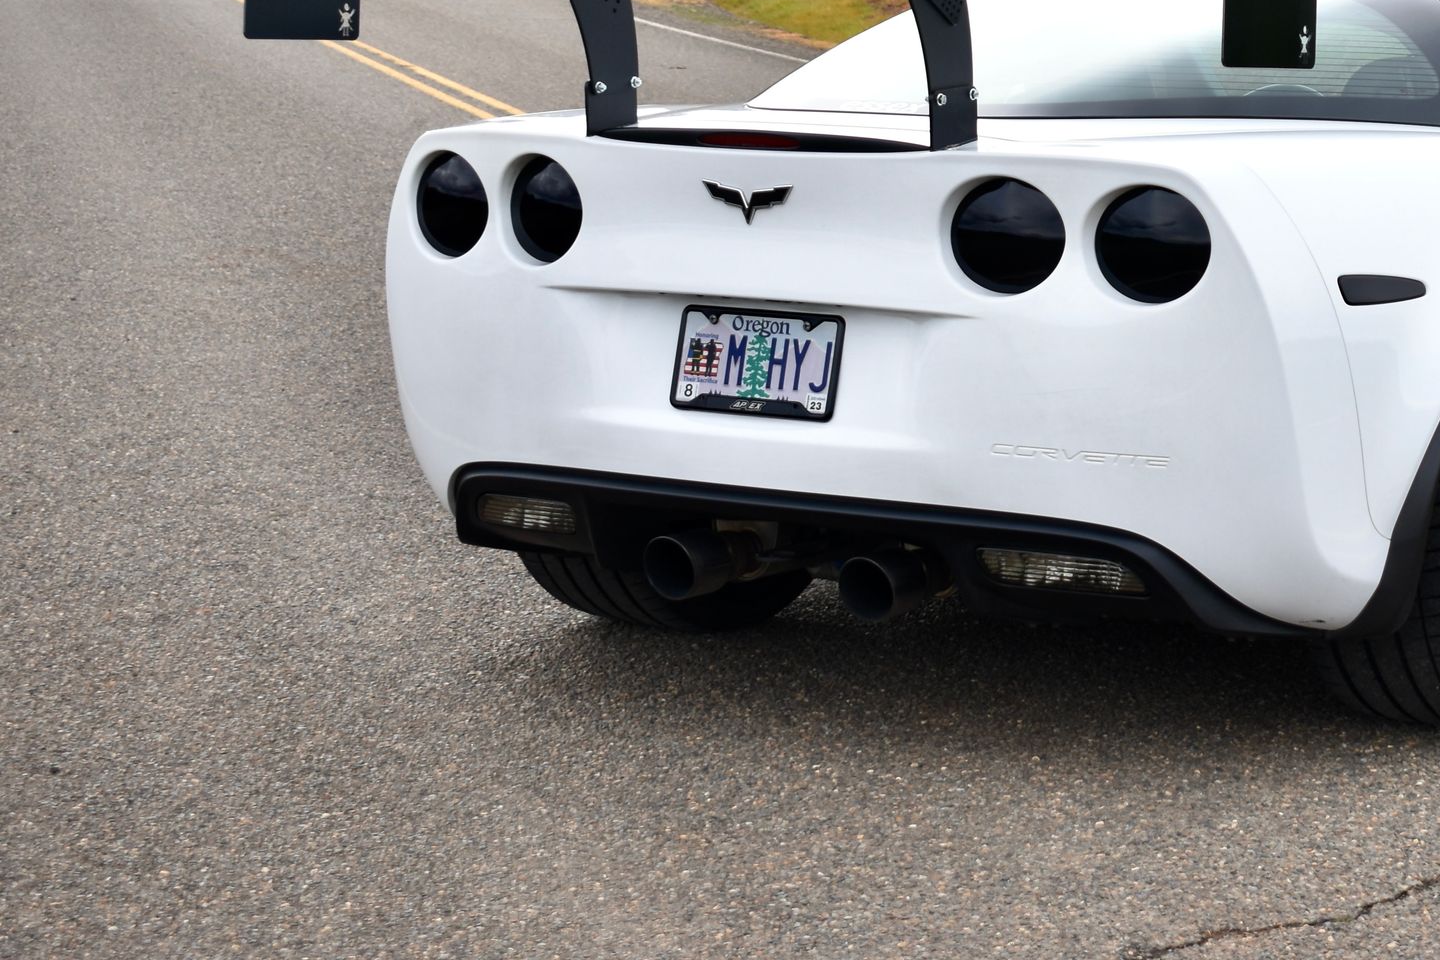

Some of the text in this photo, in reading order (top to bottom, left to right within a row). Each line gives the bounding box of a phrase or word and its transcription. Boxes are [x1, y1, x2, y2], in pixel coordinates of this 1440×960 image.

[732, 315, 791, 338] Oregon
[684, 383, 694, 397] 8
[732, 400, 764, 411] APEX
[810, 401, 822, 411] 23
[991, 442, 1171, 469] CORVETTE
